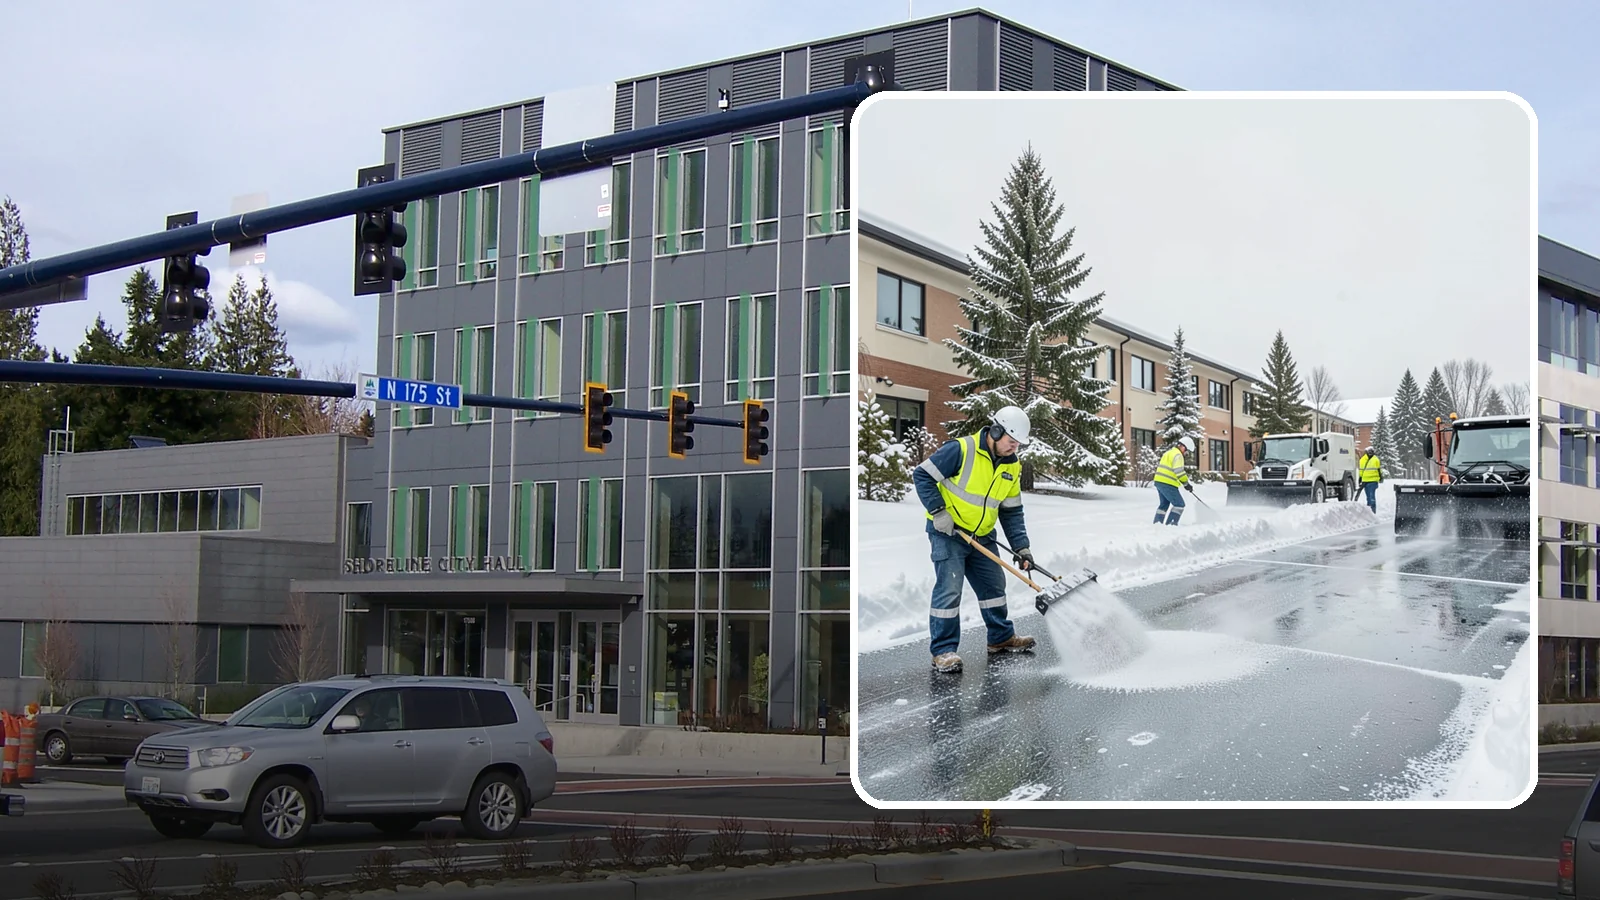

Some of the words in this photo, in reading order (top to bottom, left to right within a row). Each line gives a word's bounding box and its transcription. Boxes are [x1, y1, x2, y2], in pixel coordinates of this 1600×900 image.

[387, 380, 396, 400] N
[405, 382, 427, 403] 175
[436, 386, 451, 406] St
[344, 557, 432, 574] SHORELINE
[438, 556, 476, 572] CITY
[483, 555, 526, 571] HALL
